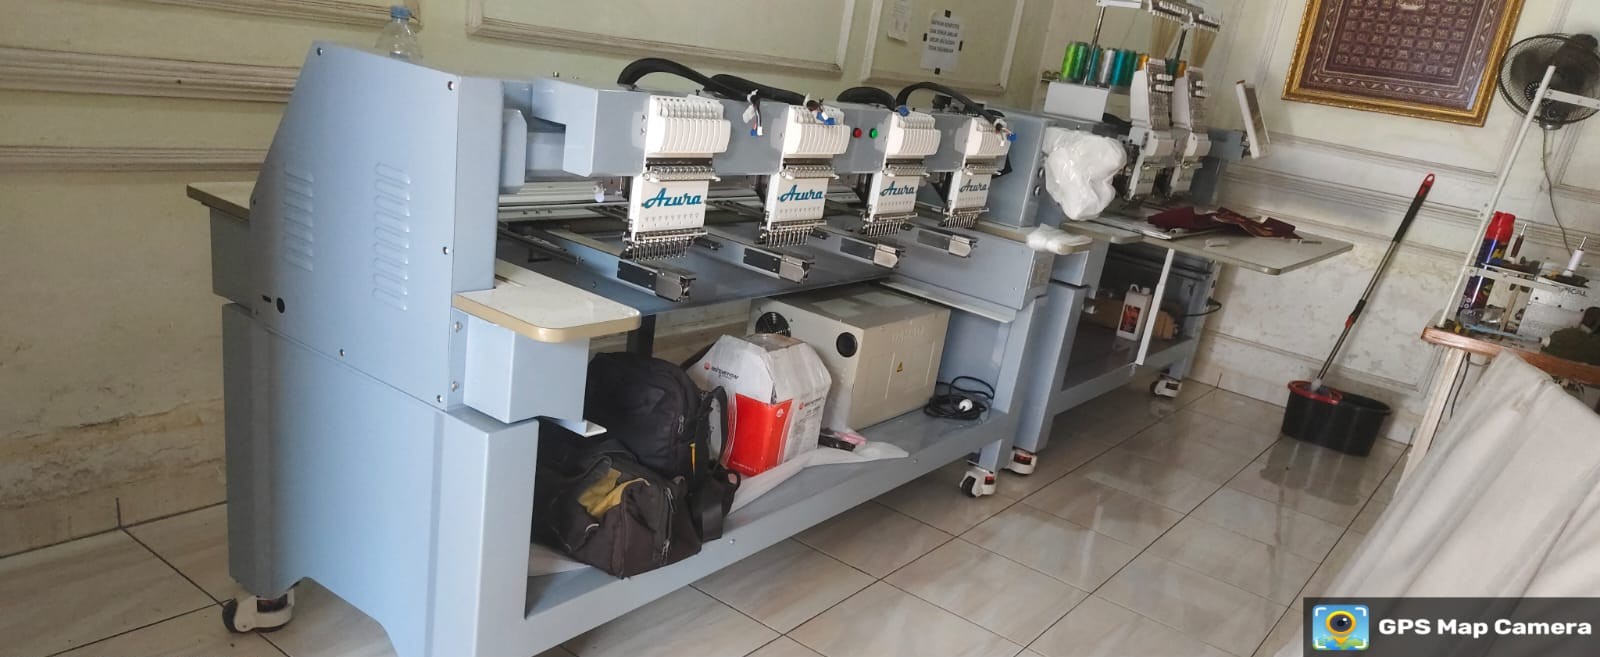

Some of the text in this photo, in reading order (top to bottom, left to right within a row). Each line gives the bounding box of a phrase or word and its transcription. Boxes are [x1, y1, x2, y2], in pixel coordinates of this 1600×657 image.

[778, 184, 823, 203] Azura
[879, 180, 915, 197] Azura
[959, 179, 988, 192] Azura
[641, 187, 702, 209] Azura
